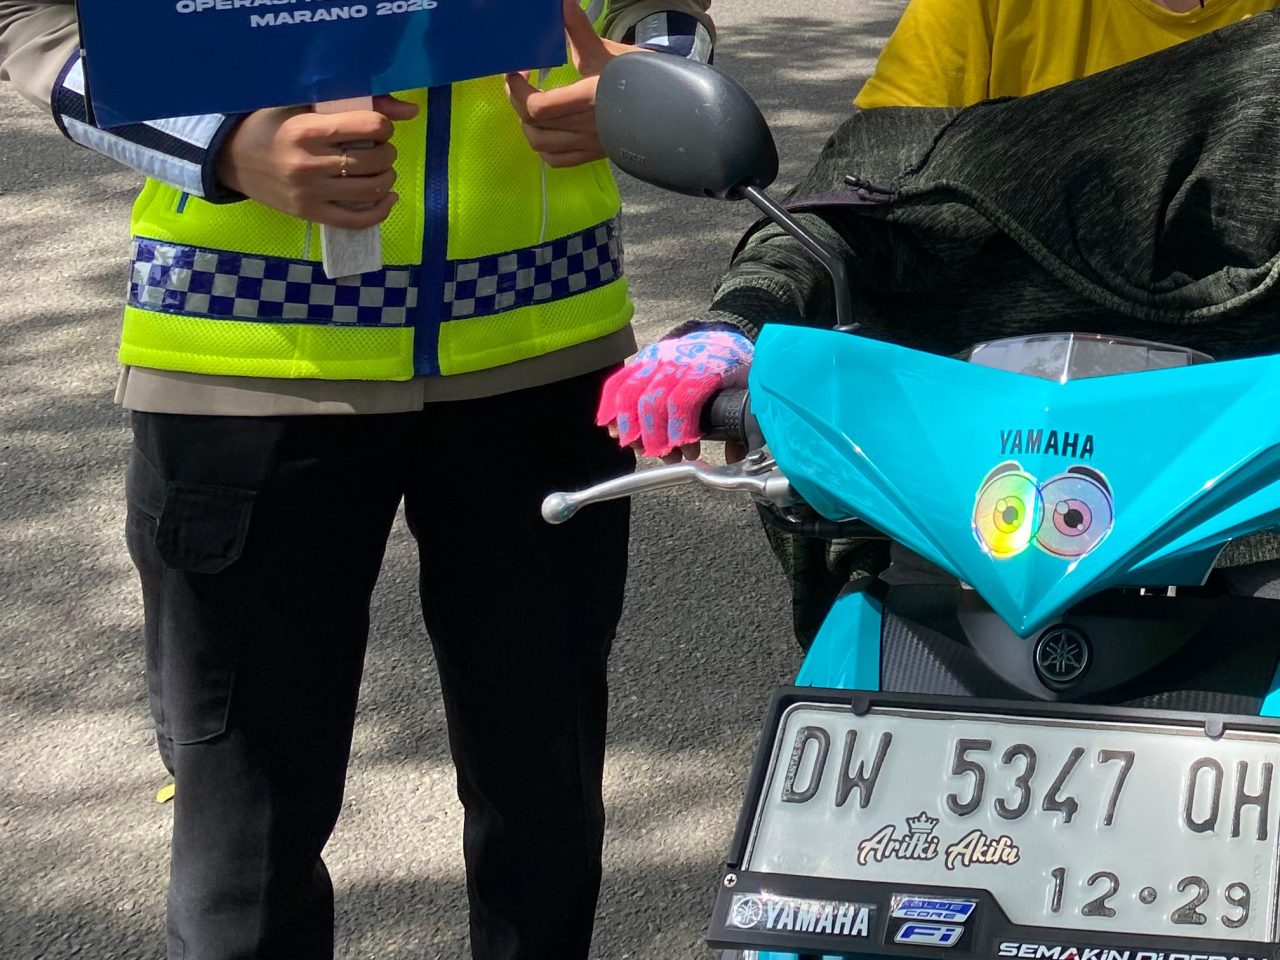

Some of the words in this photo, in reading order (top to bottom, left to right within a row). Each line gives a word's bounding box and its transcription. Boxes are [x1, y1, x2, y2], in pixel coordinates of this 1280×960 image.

[250, 5, 368, 28] MARANO
[1000, 428, 1095, 460] YAMAHA
[780, 725, 893, 809] DW
[946, 738, 1136, 826] 5347
[1183, 756, 1274, 841] QH
[765, 900, 870, 937] YAMAHA
[904, 910, 957, 920] CORE
[910, 900, 963, 911] BLUE
